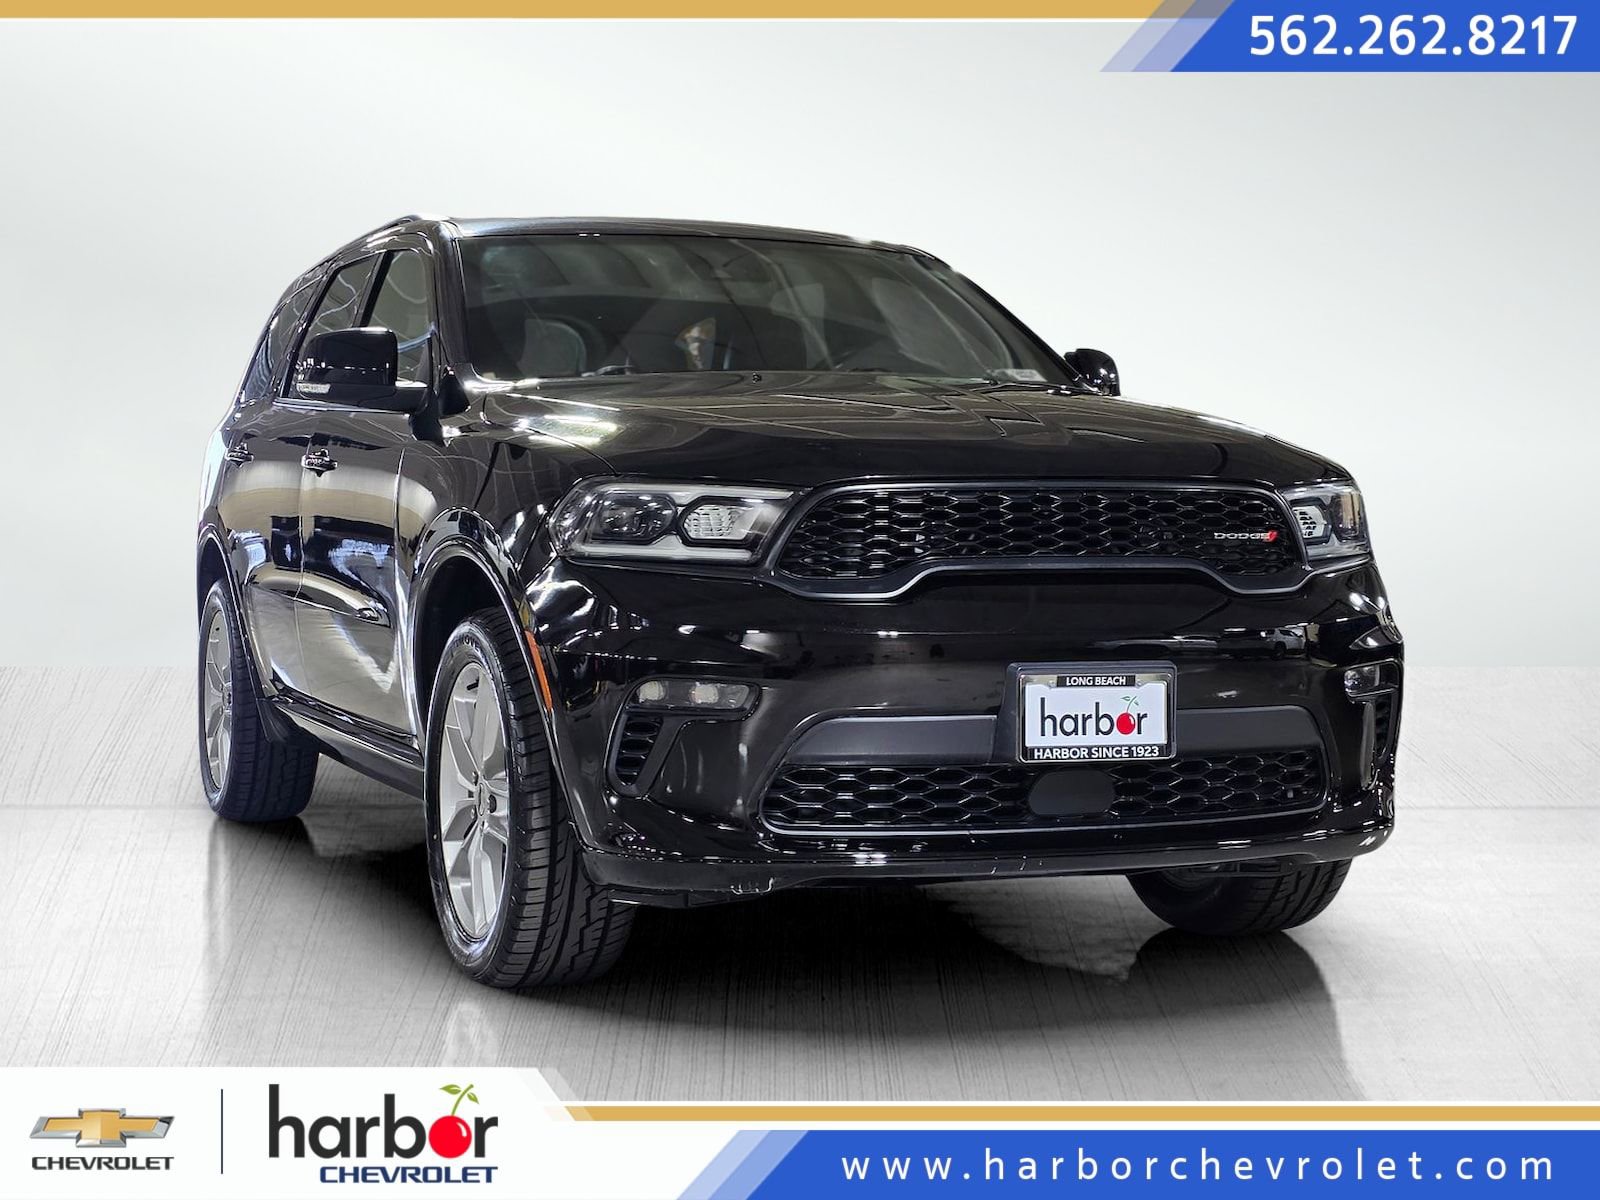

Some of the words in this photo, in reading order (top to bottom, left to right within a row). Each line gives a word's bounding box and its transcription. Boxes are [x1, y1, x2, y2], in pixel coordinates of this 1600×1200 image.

[1214, 532, 1271, 540] DODGE
[1066, 676, 1093, 686] LONG
[1095, 676, 1126, 686] BEACH
[1040, 697, 1148, 736] harbor
[1034, 748, 1089, 760] HARBOR
[1091, 747, 1130, 759] SINCE
[1131, 746, 1159, 758] 1923
